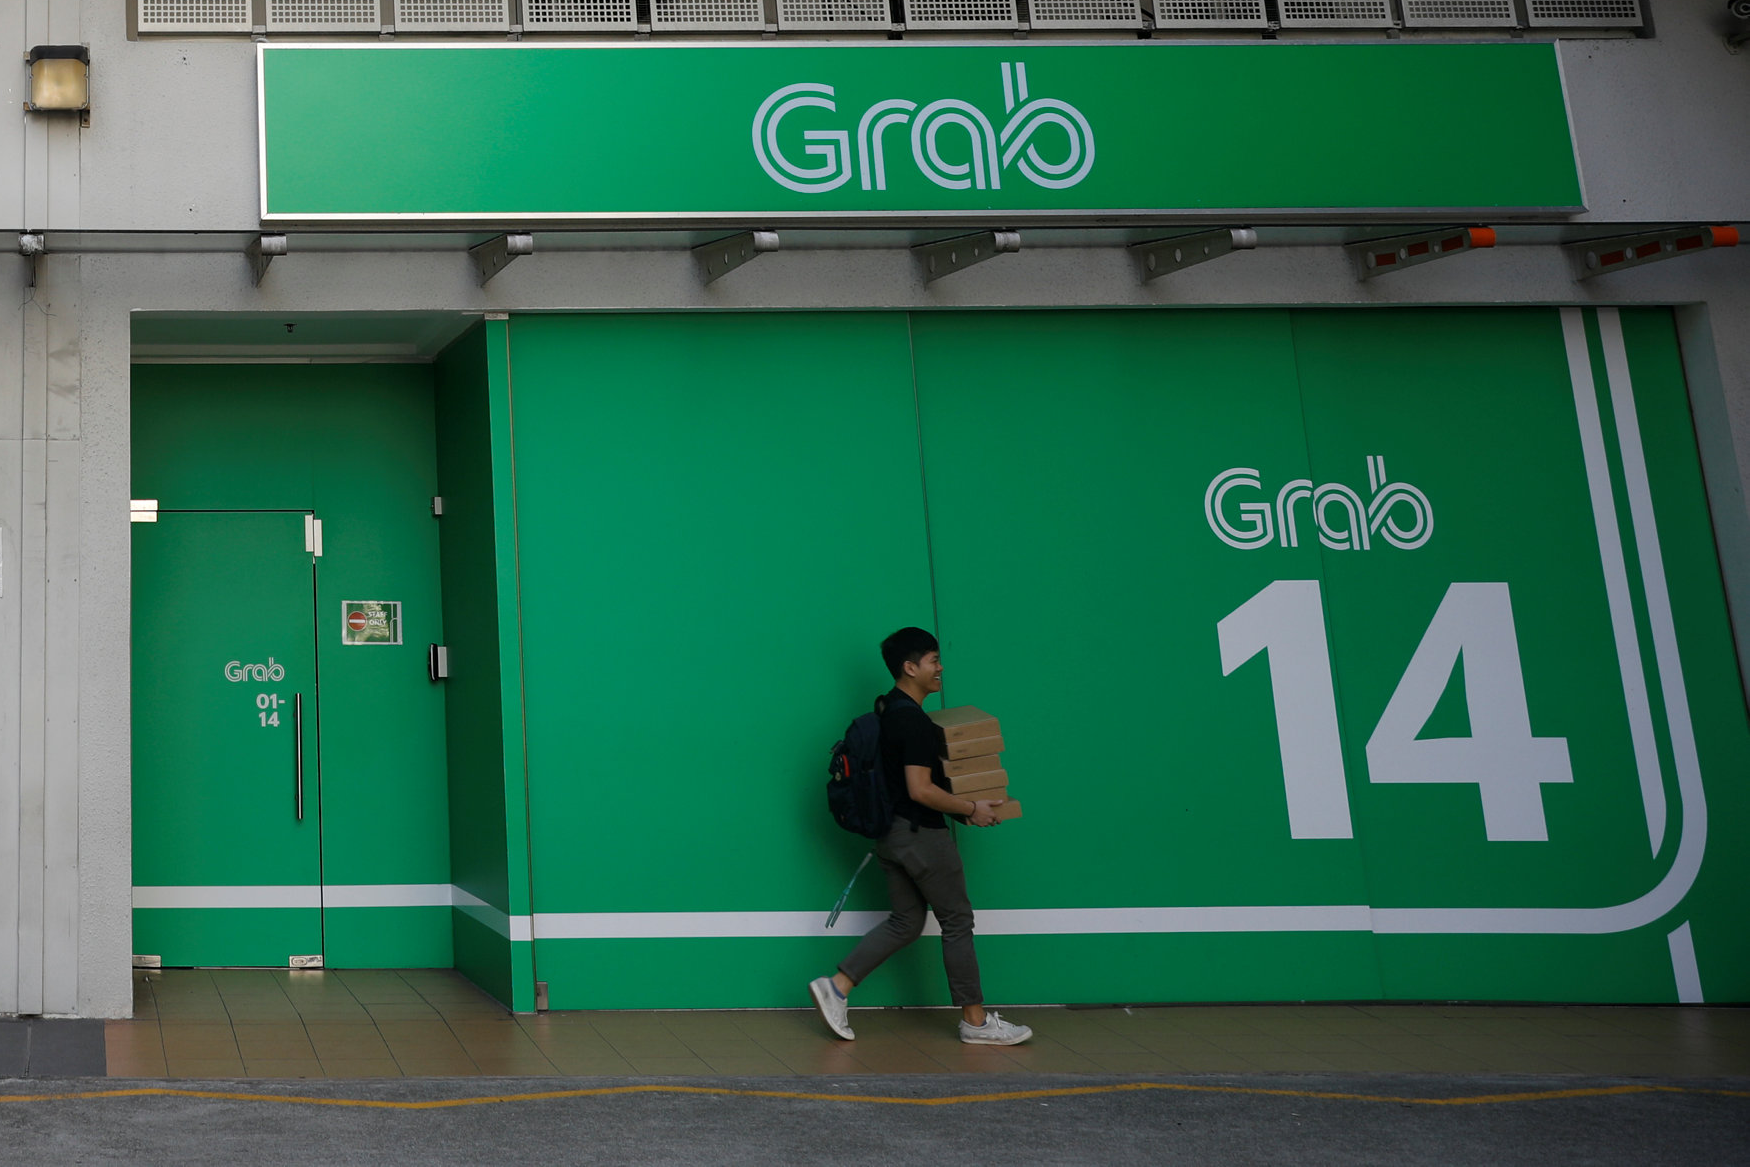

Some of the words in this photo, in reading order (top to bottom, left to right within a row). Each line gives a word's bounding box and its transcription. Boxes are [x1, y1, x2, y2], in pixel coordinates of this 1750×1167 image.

[751, 62, 1095, 194] Grab
[1204, 455, 1434, 551] Grab
[368, 610, 387, 618] STAFF
[224, 656, 285, 683] Grab
[256, 693, 286, 710] 01-
[1216, 579, 1574, 842] 14
[258, 712, 280, 728] 14
